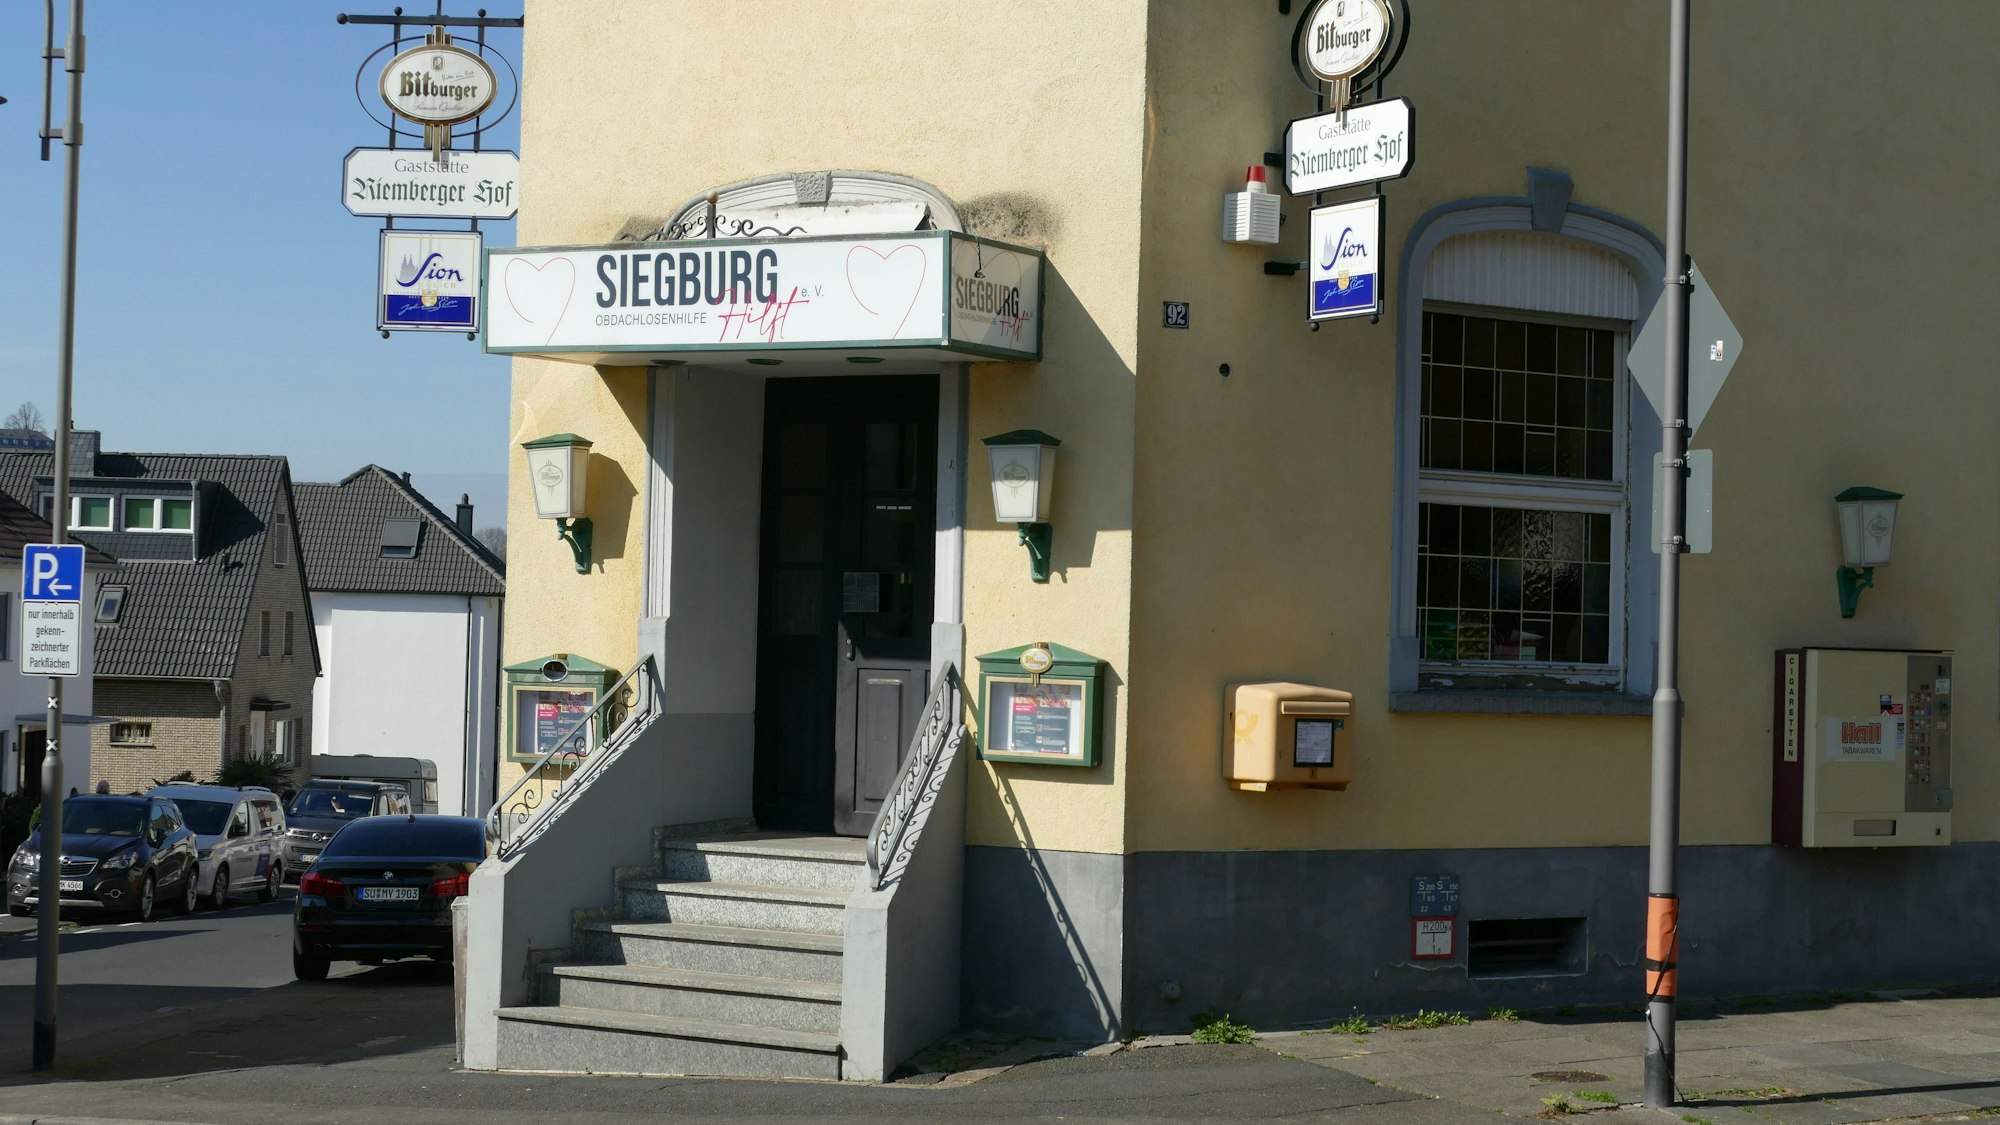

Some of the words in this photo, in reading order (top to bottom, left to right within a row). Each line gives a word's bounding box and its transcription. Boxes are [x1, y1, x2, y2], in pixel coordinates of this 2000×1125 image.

[1316, 20, 1371, 54] Bitburger
[398, 71, 478, 101] Bitburger
[1318, 118, 1371, 140] Gaststätte
[1374, 131, 1403, 167] Hof
[394, 158, 469, 174] Gaststätte
[472, 179, 514, 208] Hof
[1321, 227, 1367, 271] Sion
[396, 253, 463, 288] Sion
[595, 248, 778, 308] SIEGBURG
[801, 287, 810, 298] e.
[814, 285, 824, 297] V.
[955, 276, 1019, 318] SIEGBURG
[595, 312, 707, 327] OBDACHLOSENHILFE
[714, 286, 810, 343] Hilft
[1167, 304, 1186, 325] 92
[32, 552, 59, 596] P
[28, 610, 40, 619] nur
[41, 609, 74, 620] innerhalb
[36, 626, 65, 638] gekenn-
[29, 657, 70, 669] Parkflächen
[1842, 722, 1882, 745] Hall
[1842, 747, 1882, 756] TABAKWAREN
[364, 888, 376, 899] SU
[381, 888, 394, 899] MY
[395, 888, 418, 899] 1903
